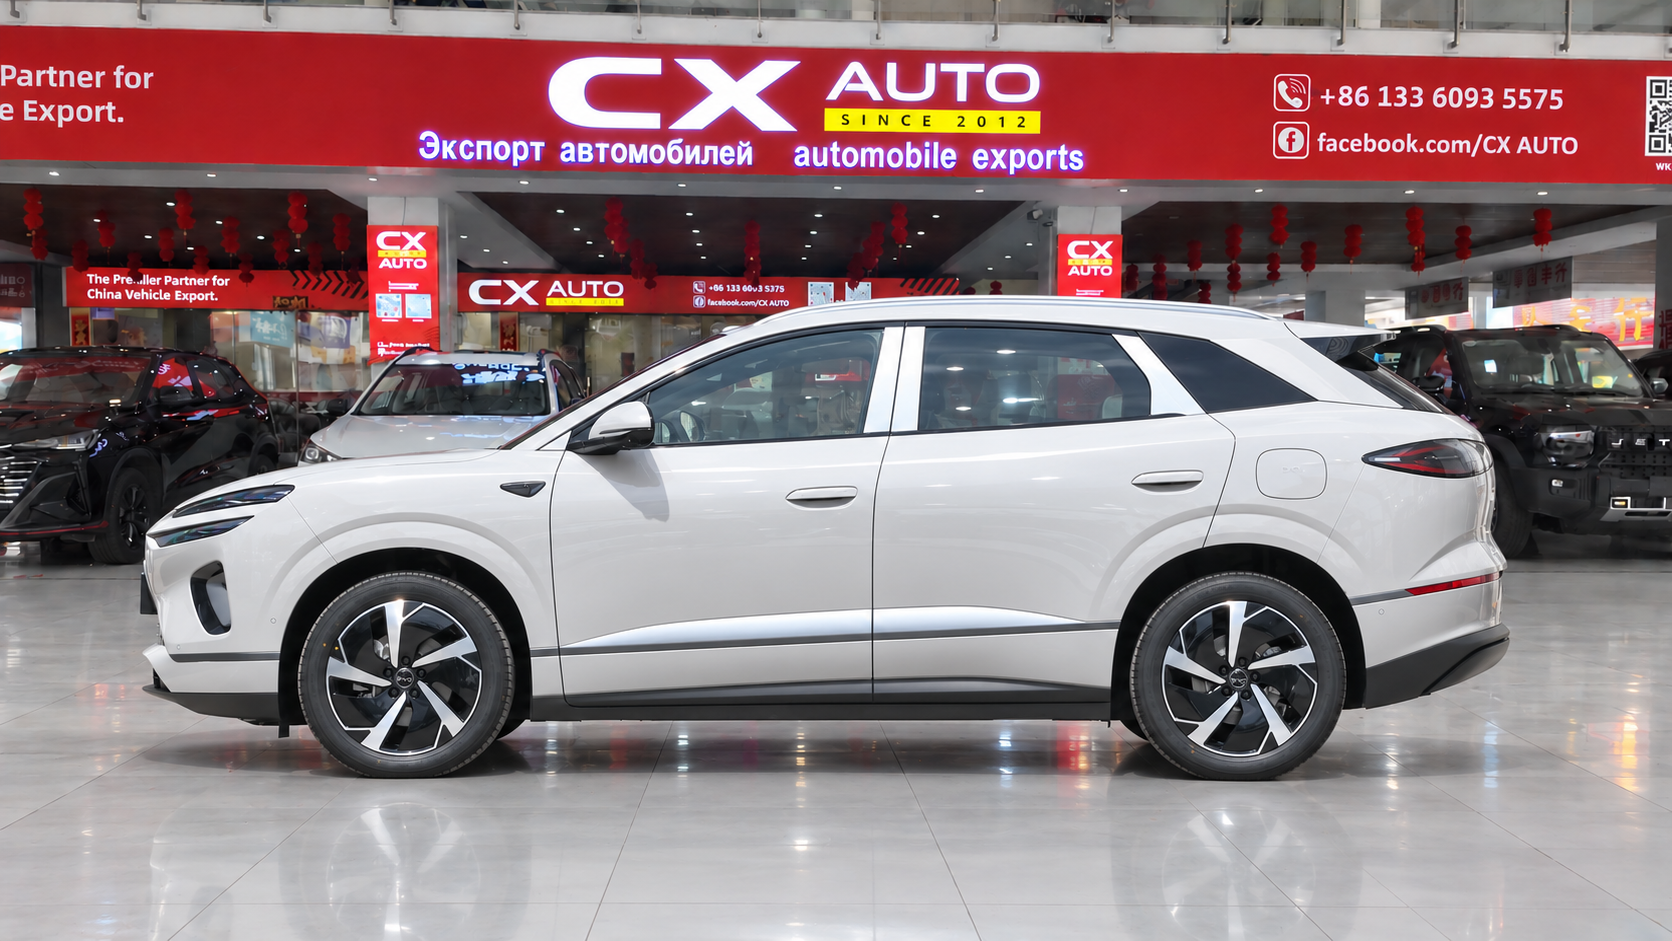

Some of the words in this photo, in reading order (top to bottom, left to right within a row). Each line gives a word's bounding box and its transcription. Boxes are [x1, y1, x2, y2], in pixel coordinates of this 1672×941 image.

[1, 64, 106, 89] Partner
[113, 65, 154, 89] for
[825, 61, 1041, 103] AUTO
[548, 56, 801, 132] CX
[1320, 85, 1370, 107] +86
[1377, 86, 1424, 108] 133
[1432, 86, 1494, 109] 6093
[1502, 88, 1564, 110] 5575
[23, 100, 125, 128] Export.
[841, 113, 931, 127] SINCE
[956, 115, 1026, 128] 2012
[418, 131, 545, 167] Экспорт
[560, 138, 753, 166] автомобилей
[1317, 133, 1511, 157] facebook.com/CX
[1517, 136, 1579, 155] AUTO
[794, 141, 957, 169] automobile
[972, 144, 1084, 175] exports
[376, 231, 426, 250] CX
[1067, 240, 1113, 259] CX
[379, 258, 427, 269] AUTO
[1067, 265, 1113, 276] AUTO
[86, 273, 110, 284] The
[164, 275, 210, 286] Partner
[212, 275, 230, 286] for
[547, 280, 624, 297] AUTO
[726, 284, 741, 292] 133
[86, 288, 122, 300] China
[125, 289, 171, 300] Vehicle
[175, 290, 219, 303] Export.
[469, 279, 539, 305] CX
[769, 299, 790, 307] AUTO
